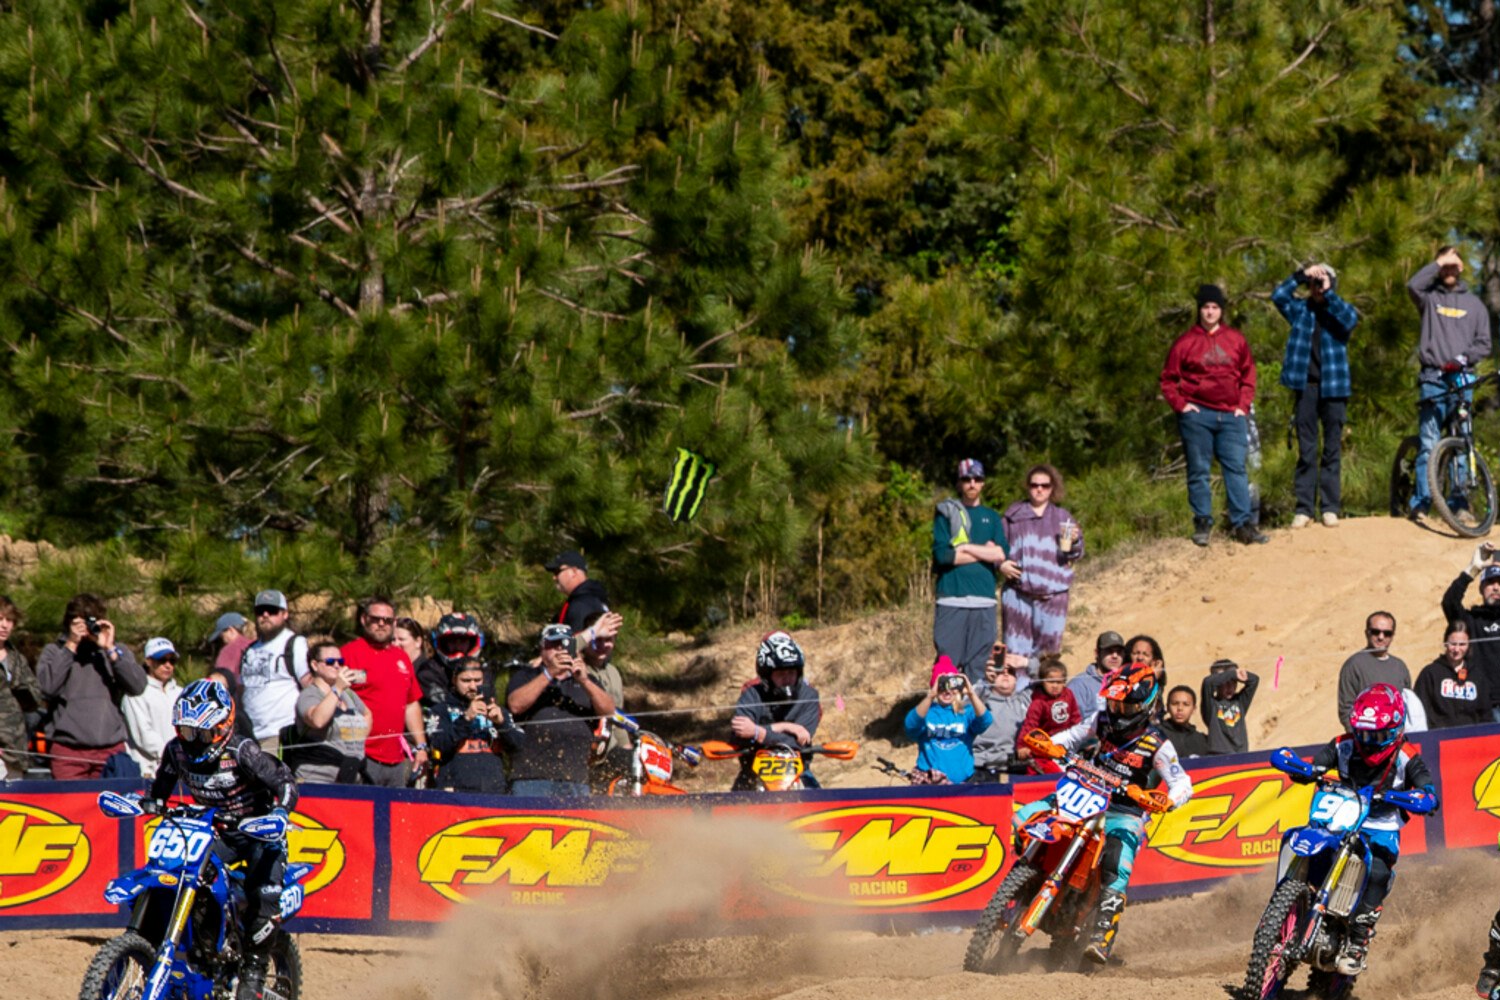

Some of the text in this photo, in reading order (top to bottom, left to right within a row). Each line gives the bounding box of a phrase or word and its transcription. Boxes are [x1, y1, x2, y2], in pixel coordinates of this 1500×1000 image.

[758, 759, 800, 777] 226
[1060, 782, 1106, 819] 406
[1147, 778, 1318, 848] FM
[147, 827, 212, 862] 650
[1240, 839, 1281, 856] RACI
[850, 880, 908, 895] RACING
